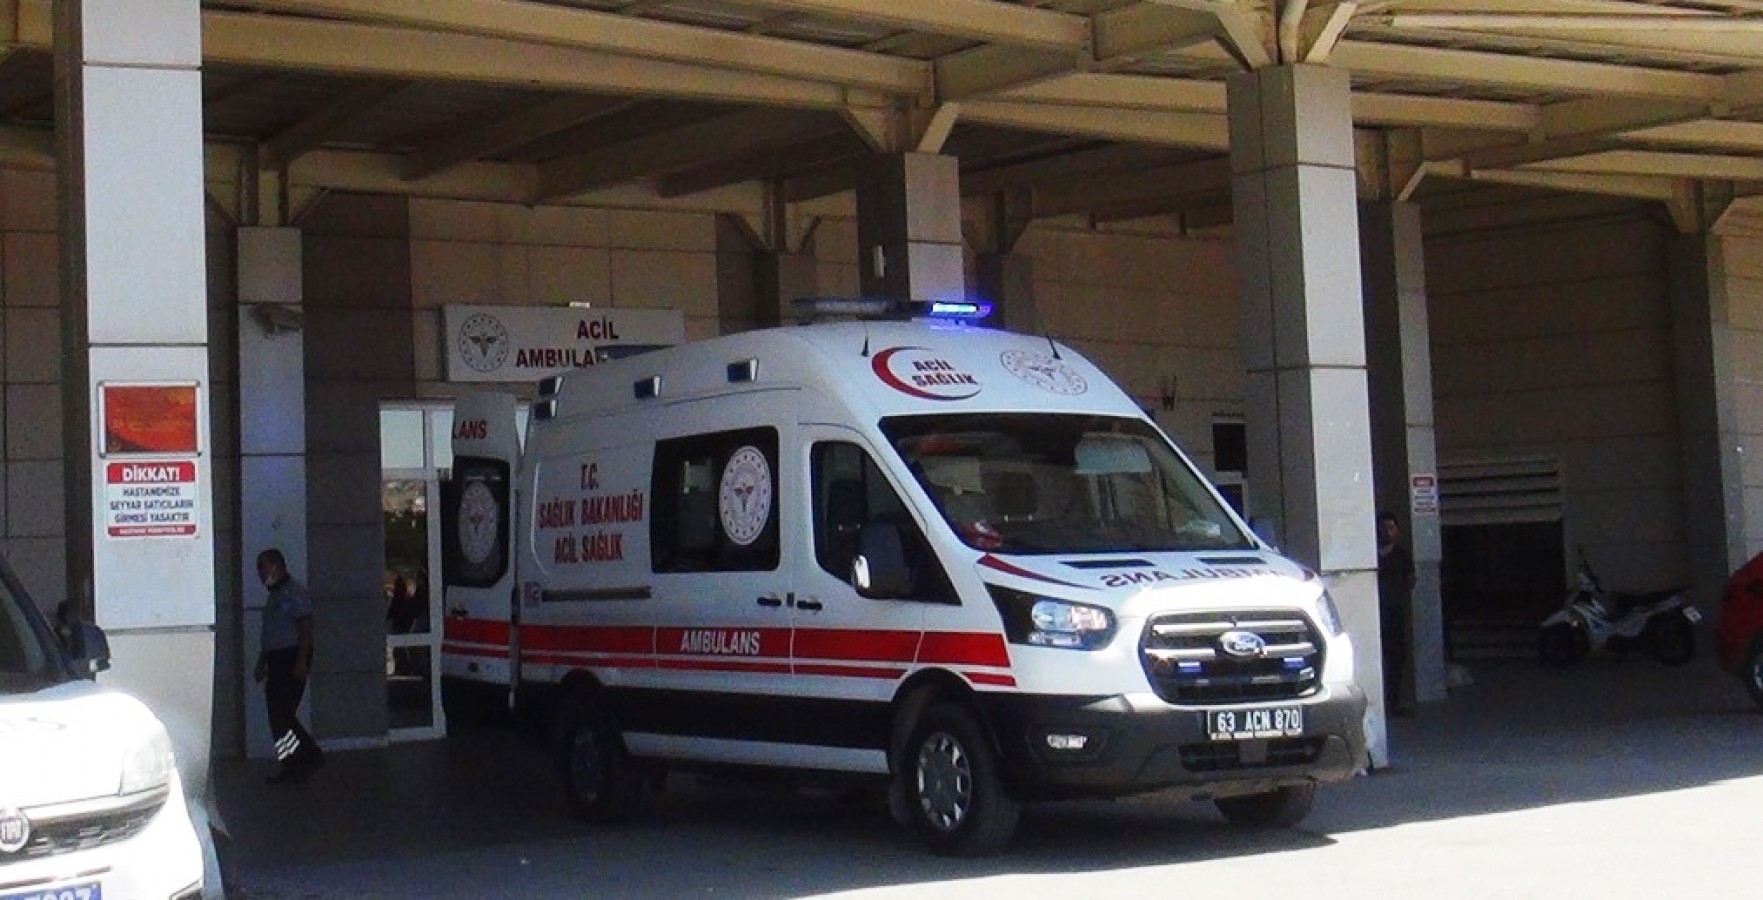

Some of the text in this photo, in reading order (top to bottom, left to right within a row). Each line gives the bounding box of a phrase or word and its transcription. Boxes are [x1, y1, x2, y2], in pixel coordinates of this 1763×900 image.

[577, 317, 619, 340] ACİL
[912, 358, 956, 372] ACİL
[911, 372, 979, 386] SAĞLIK
[122, 464, 180, 482] DİKKAT!
[539, 488, 643, 529] SAĞLIK BAKANLIĞI
[554, 528, 624, 565] ACİL SAĞLIK
[680, 630, 761, 656] AMBULANS
[1217, 707, 1300, 732] 63 ACN 870
